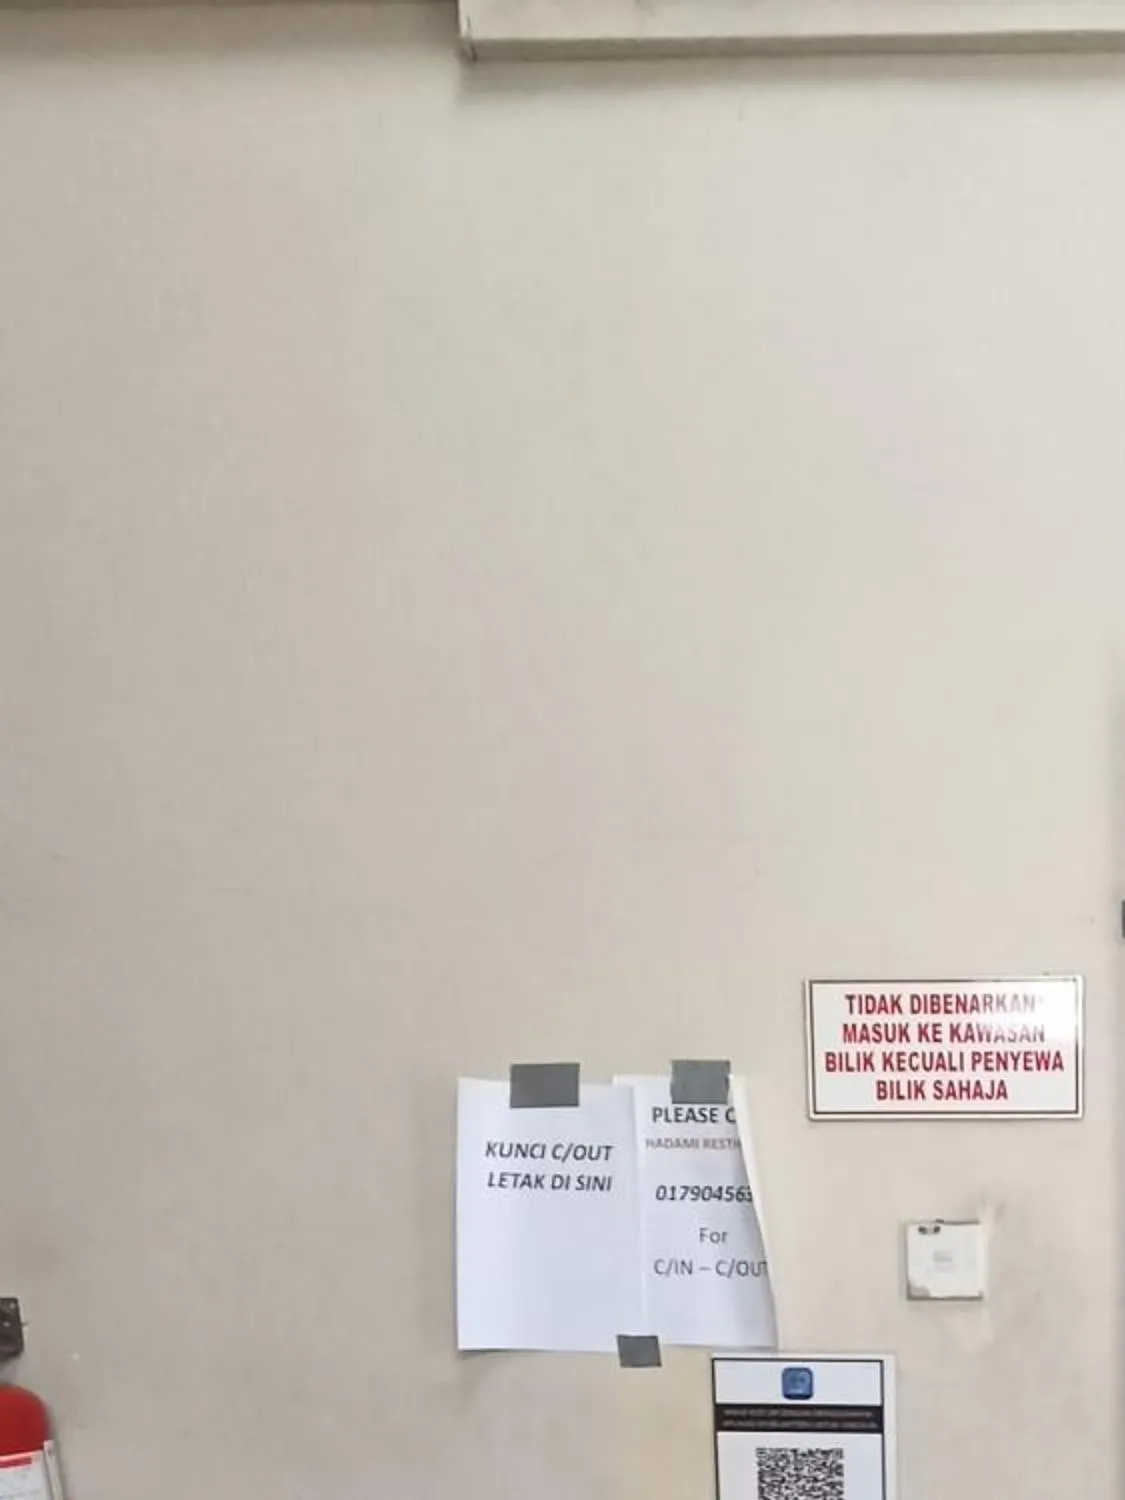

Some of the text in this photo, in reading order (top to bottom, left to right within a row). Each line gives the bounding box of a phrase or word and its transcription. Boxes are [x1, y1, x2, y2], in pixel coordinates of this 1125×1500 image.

[845, 993, 1036, 1015] TIDAK DIBENARKAN
[842, 1023, 1045, 1044] MASUK KE KAWASAN
[825, 1051, 1064, 1072] BILIK KECUALI PENYEWA
[876, 1079, 1008, 1100] BILIK SAHAJA
[652, 1106, 719, 1123] PLEASE
[485, 1141, 614, 1162] KUNCI C/OUT
[487, 1171, 612, 1191] LETAK DI SINI
[699, 1227, 728, 1244] For
[654, 1259, 693, 1277] C/IN
